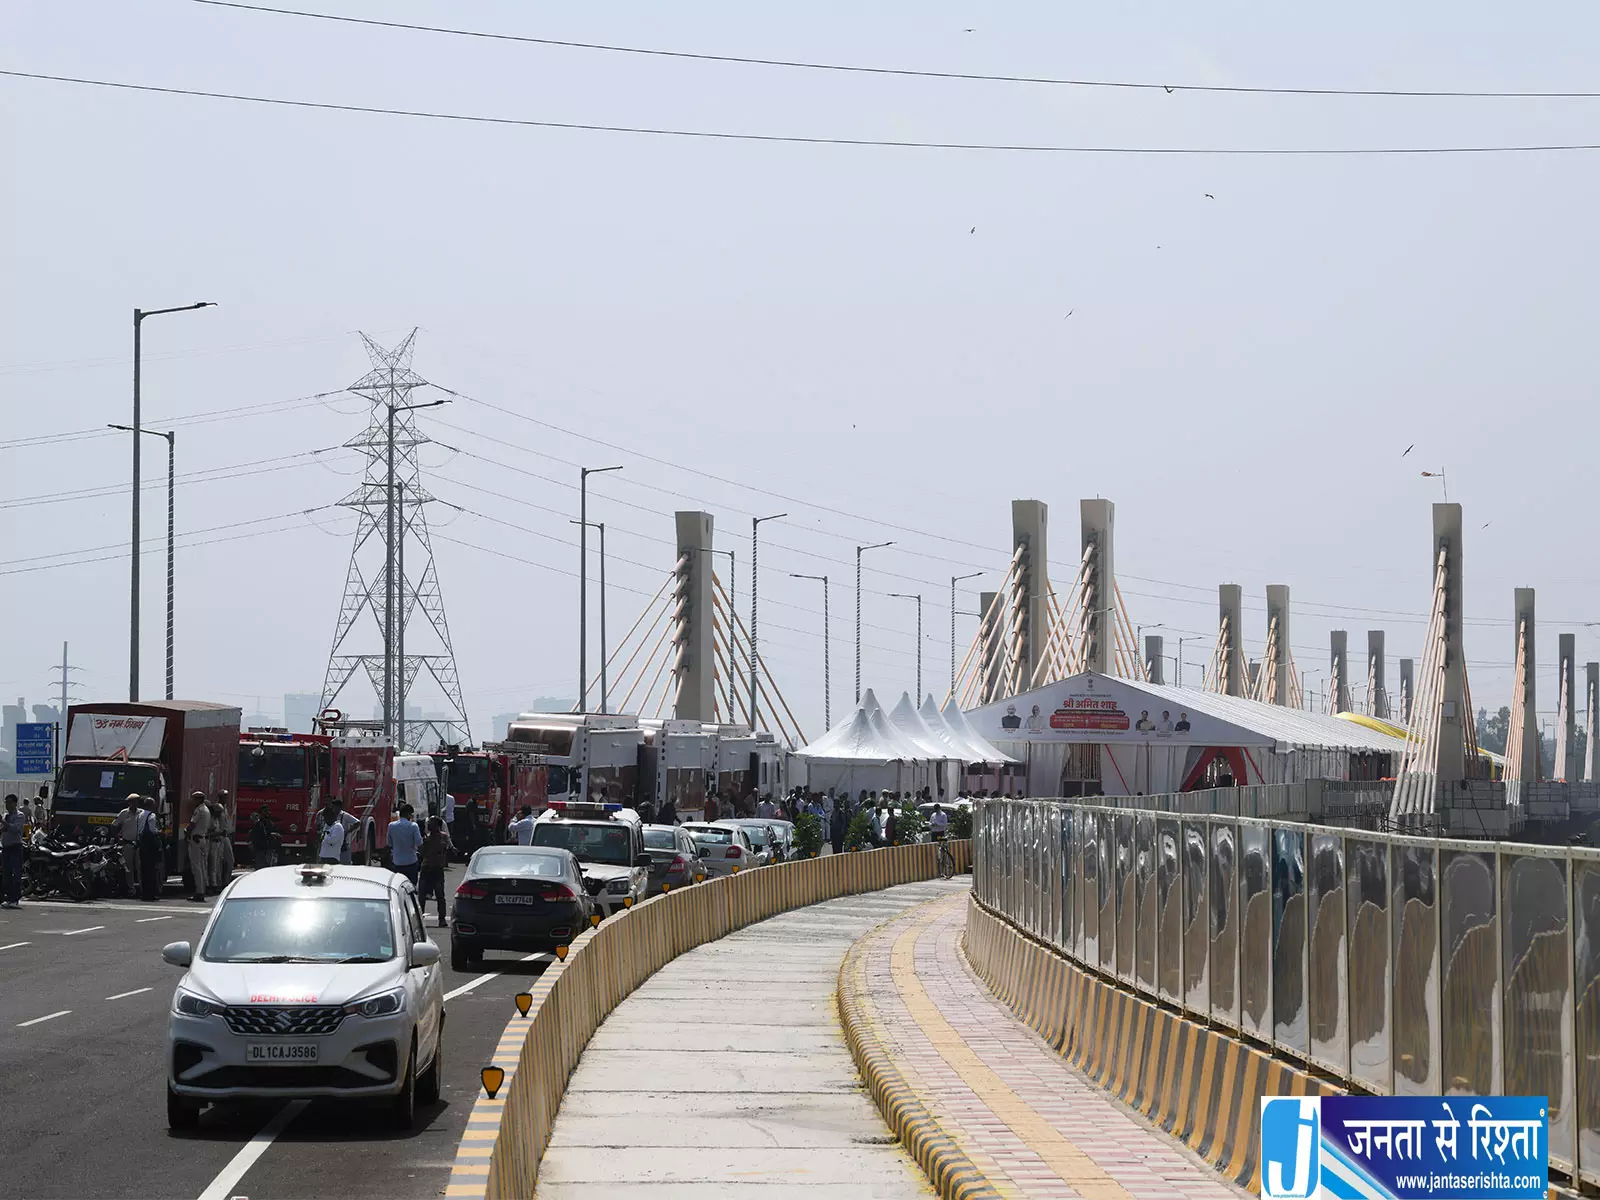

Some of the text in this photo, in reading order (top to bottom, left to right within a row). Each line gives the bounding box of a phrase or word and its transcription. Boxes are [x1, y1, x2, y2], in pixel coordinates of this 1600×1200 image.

[1063, 698, 1118, 710] श्री अमित शाह
[286, 803, 300, 811] FIRE
[250, 994, 279, 1003] DELHI
[252, 1046, 317, 1059] DL1CAJ3586
